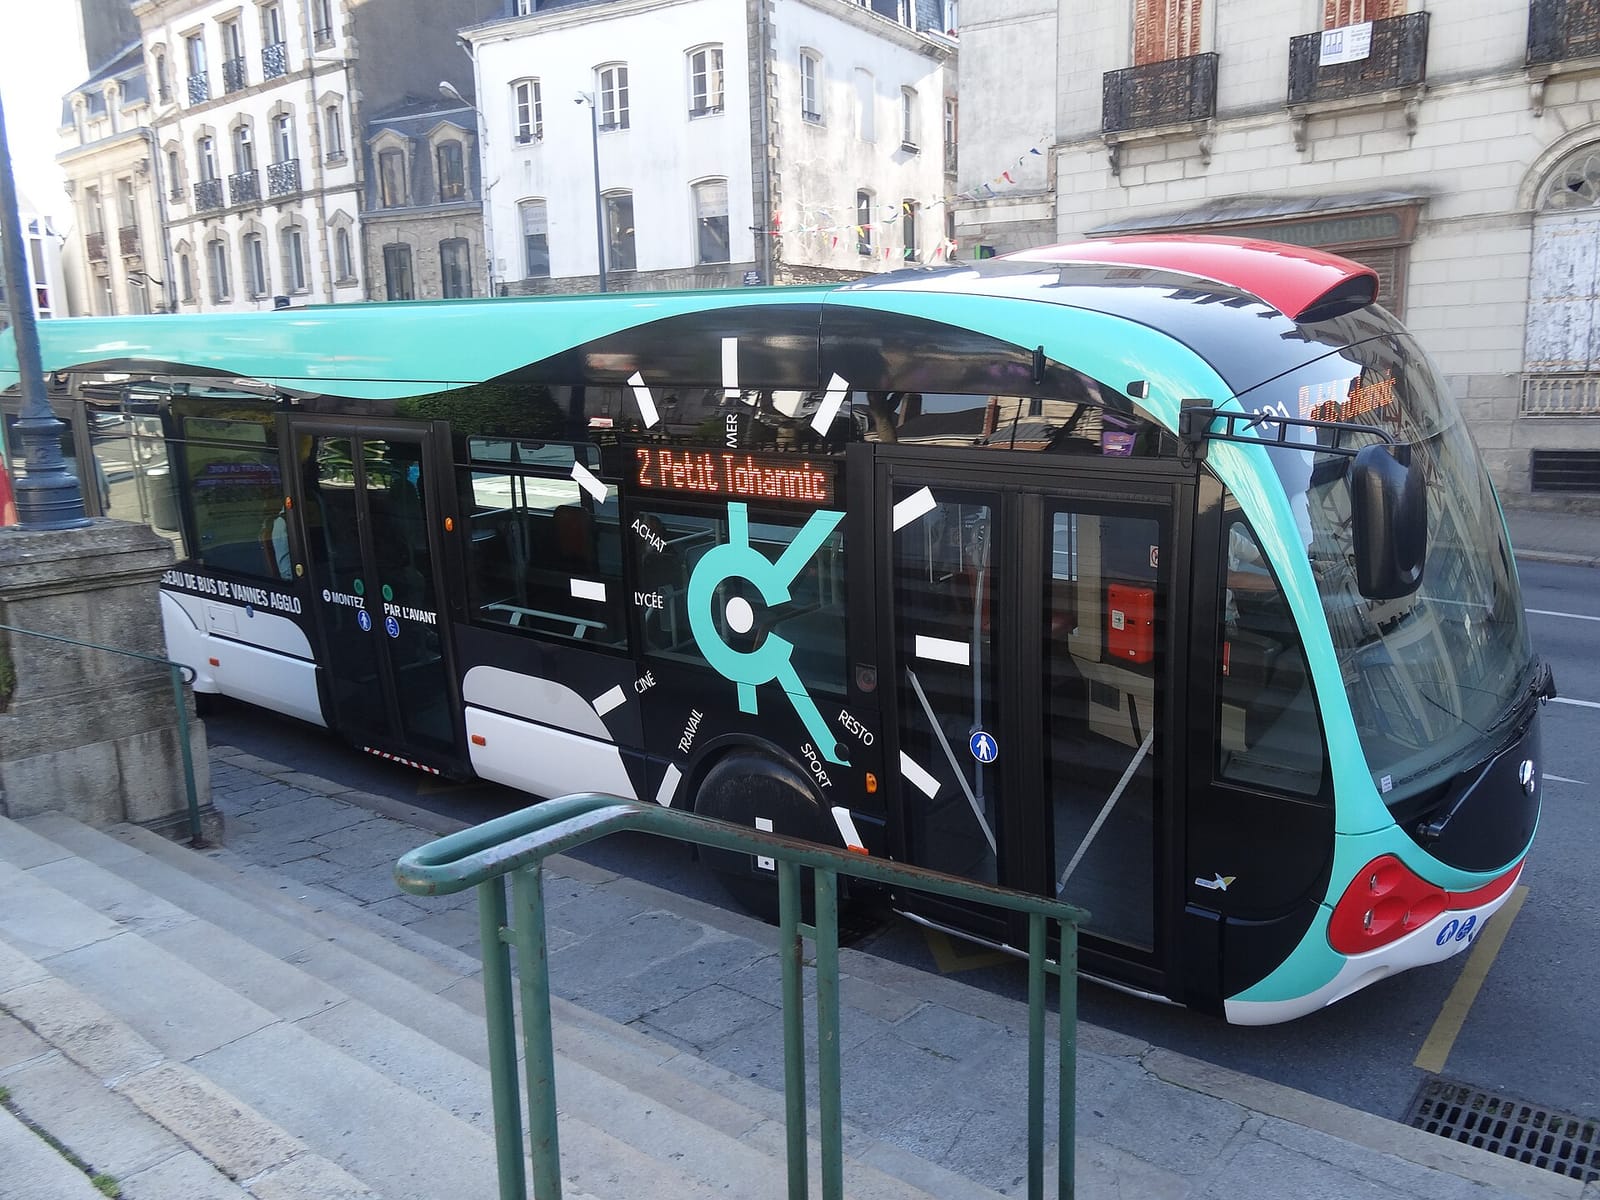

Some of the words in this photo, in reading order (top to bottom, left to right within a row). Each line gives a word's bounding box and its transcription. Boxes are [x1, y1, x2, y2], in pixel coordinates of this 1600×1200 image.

[726, 413, 739, 449] MER
[637, 449, 652, 487] 2
[658, 449, 719, 491] Petit
[722, 454, 827, 500] Tohannic
[631, 518, 668, 554] ACHAT
[184, 573, 197, 590] DE
[196, 575, 217, 594] BUS
[217, 580, 231, 598] DE
[230, 583, 269, 607] VANNES
[270, 592, 302, 615] AGGLO
[331, 591, 365, 609] MONTEZ
[634, 591, 664, 609] LYCÉE
[384, 602, 401, 618] PAR
[402, 605, 437, 625] L'AVANT
[634, 670, 657, 694] CINÉ
[678, 708, 703, 754] TRAVAIL
[837, 709, 874, 746] RESTO
[801, 743, 832, 789] SPORT
